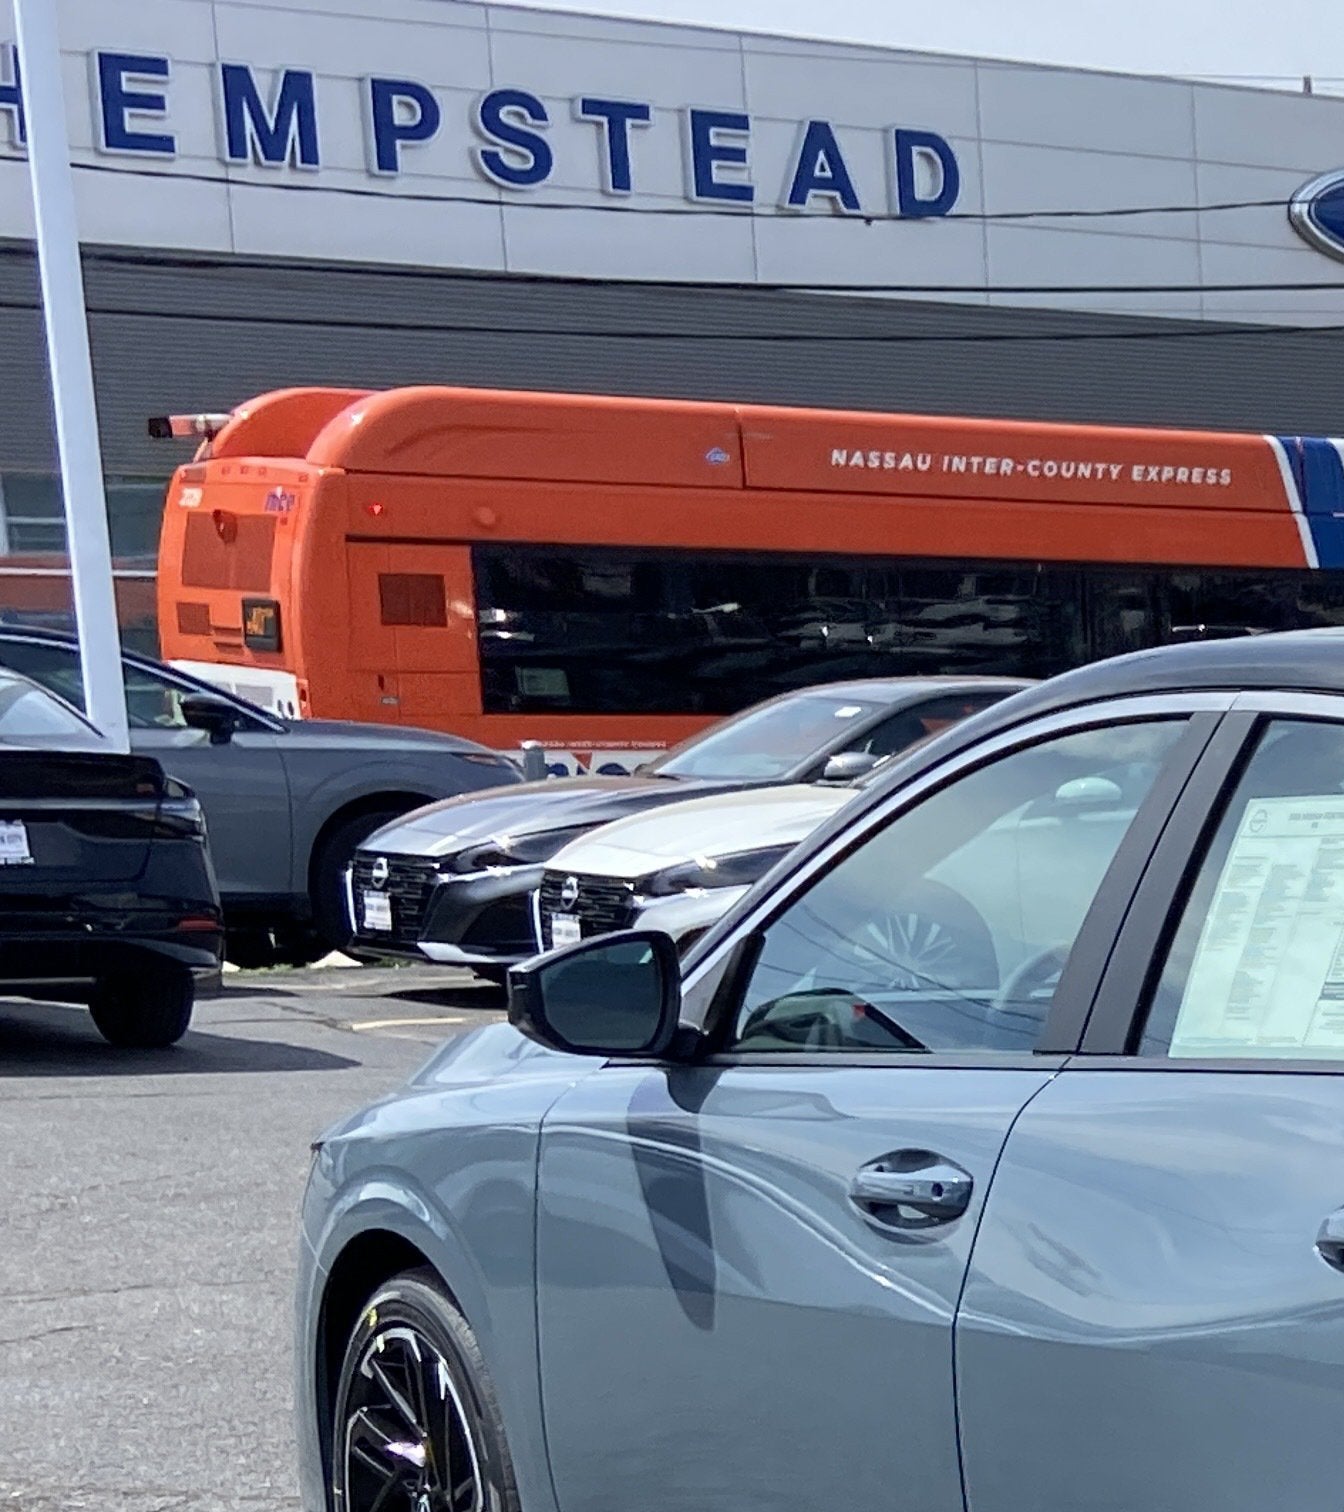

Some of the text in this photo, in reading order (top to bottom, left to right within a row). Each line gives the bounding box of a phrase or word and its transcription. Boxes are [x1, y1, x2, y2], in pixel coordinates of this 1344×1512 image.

[831, 448, 1232, 486] NASSAU INTER-COUNTY EXPRESS
